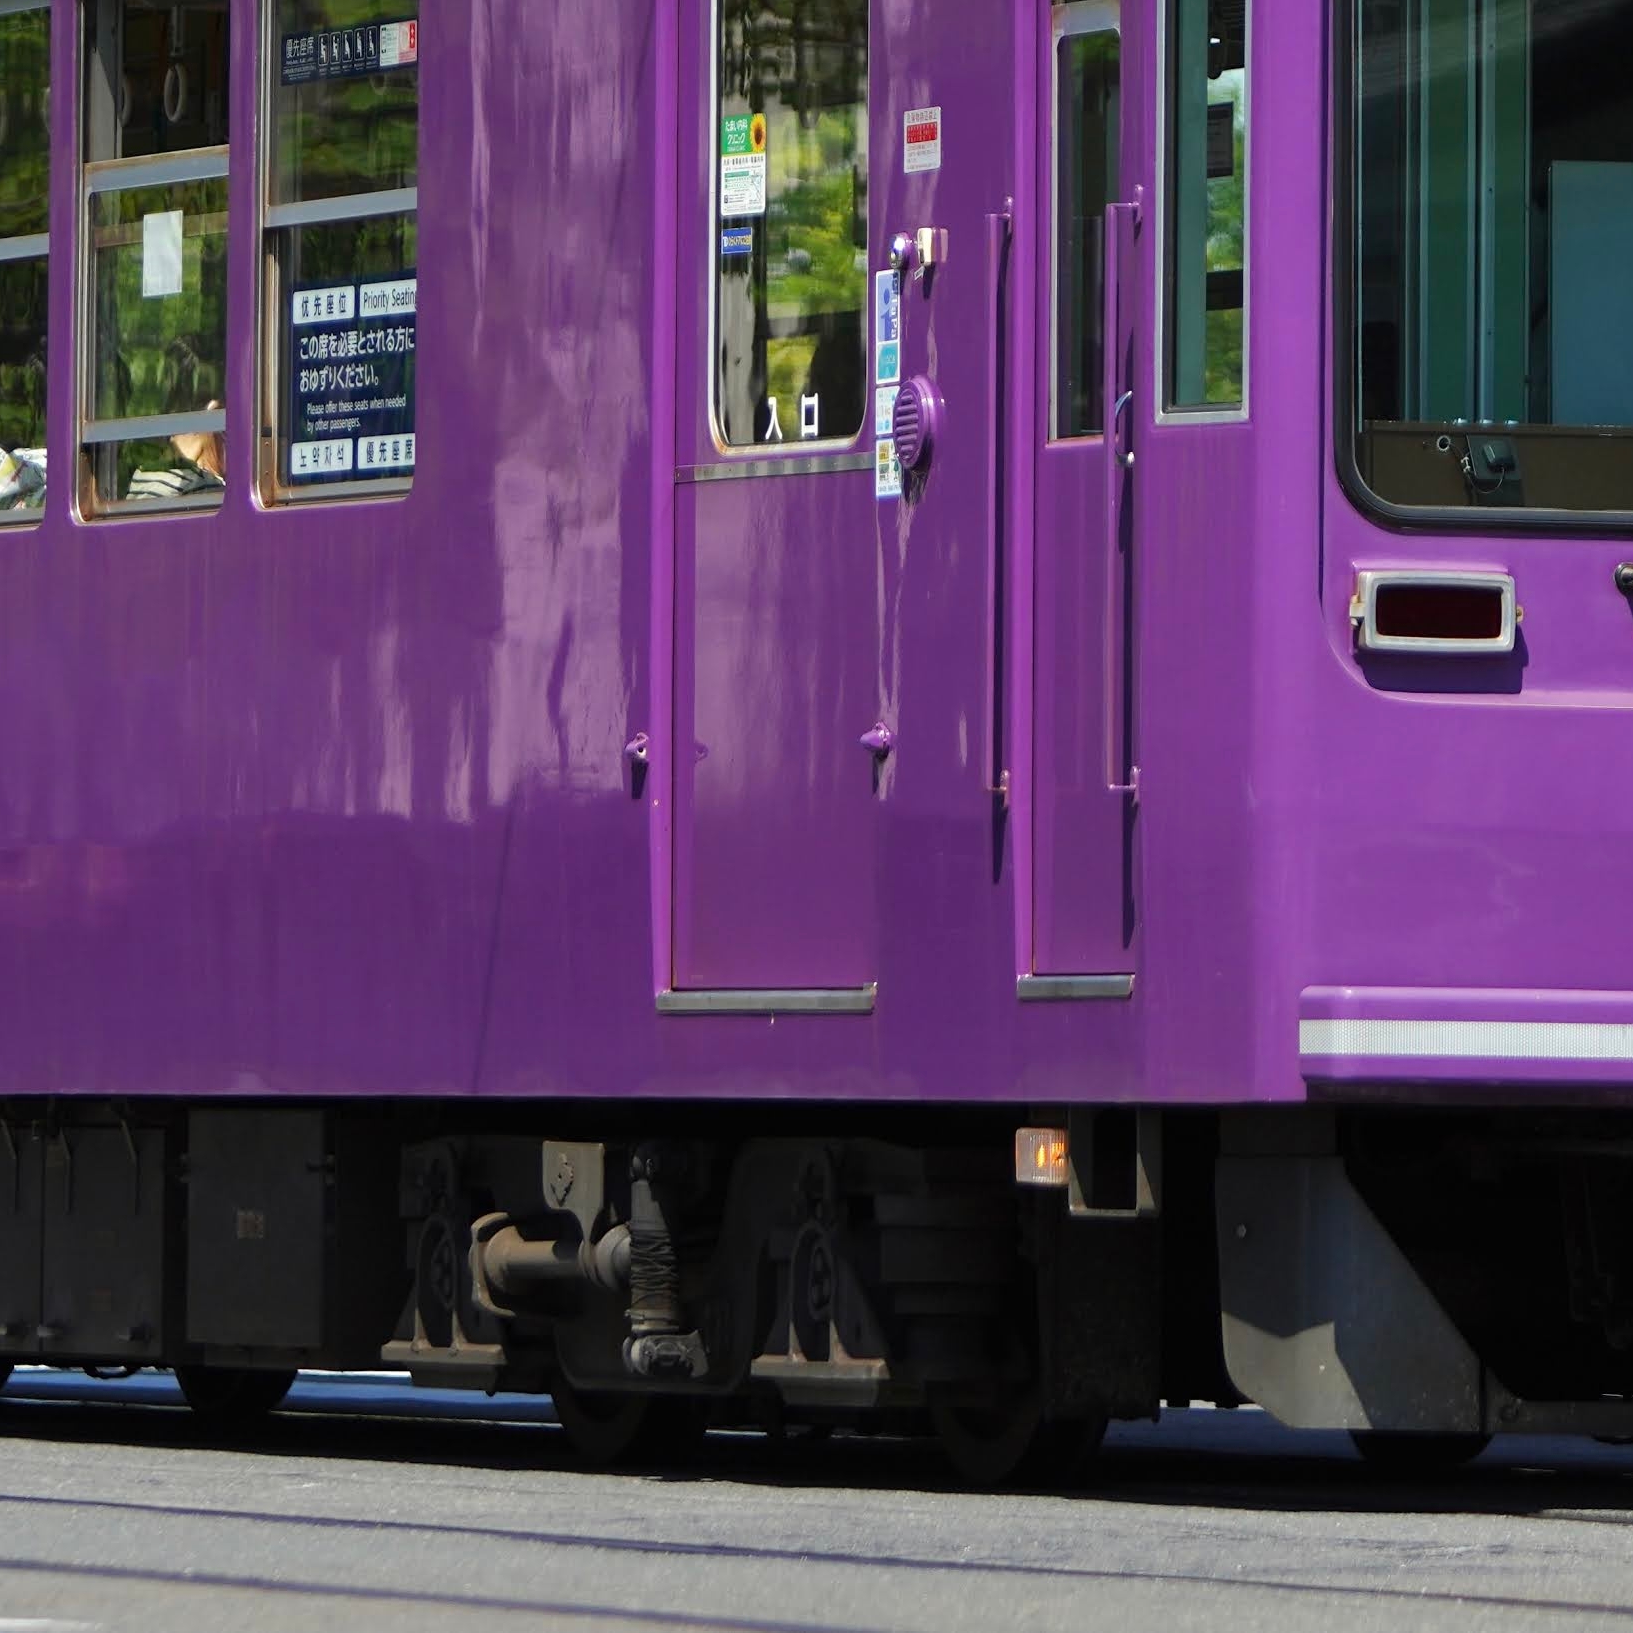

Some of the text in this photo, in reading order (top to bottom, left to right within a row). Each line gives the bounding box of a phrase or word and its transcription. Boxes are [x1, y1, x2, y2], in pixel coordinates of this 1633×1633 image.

[301, 291, 347, 318] 优先座位
[363, 287, 416, 313] Priority Seatin
[299, 326, 415, 360] この席を必要とされる方に
[299, 363, 379, 393] おゆずりください。
[307, 393, 407, 416] Please offer these seats when needed
[765, 392, 819, 440] 入口
[307, 416, 361, 434] by other passengers.
[366, 439, 413, 464] 優先座席
